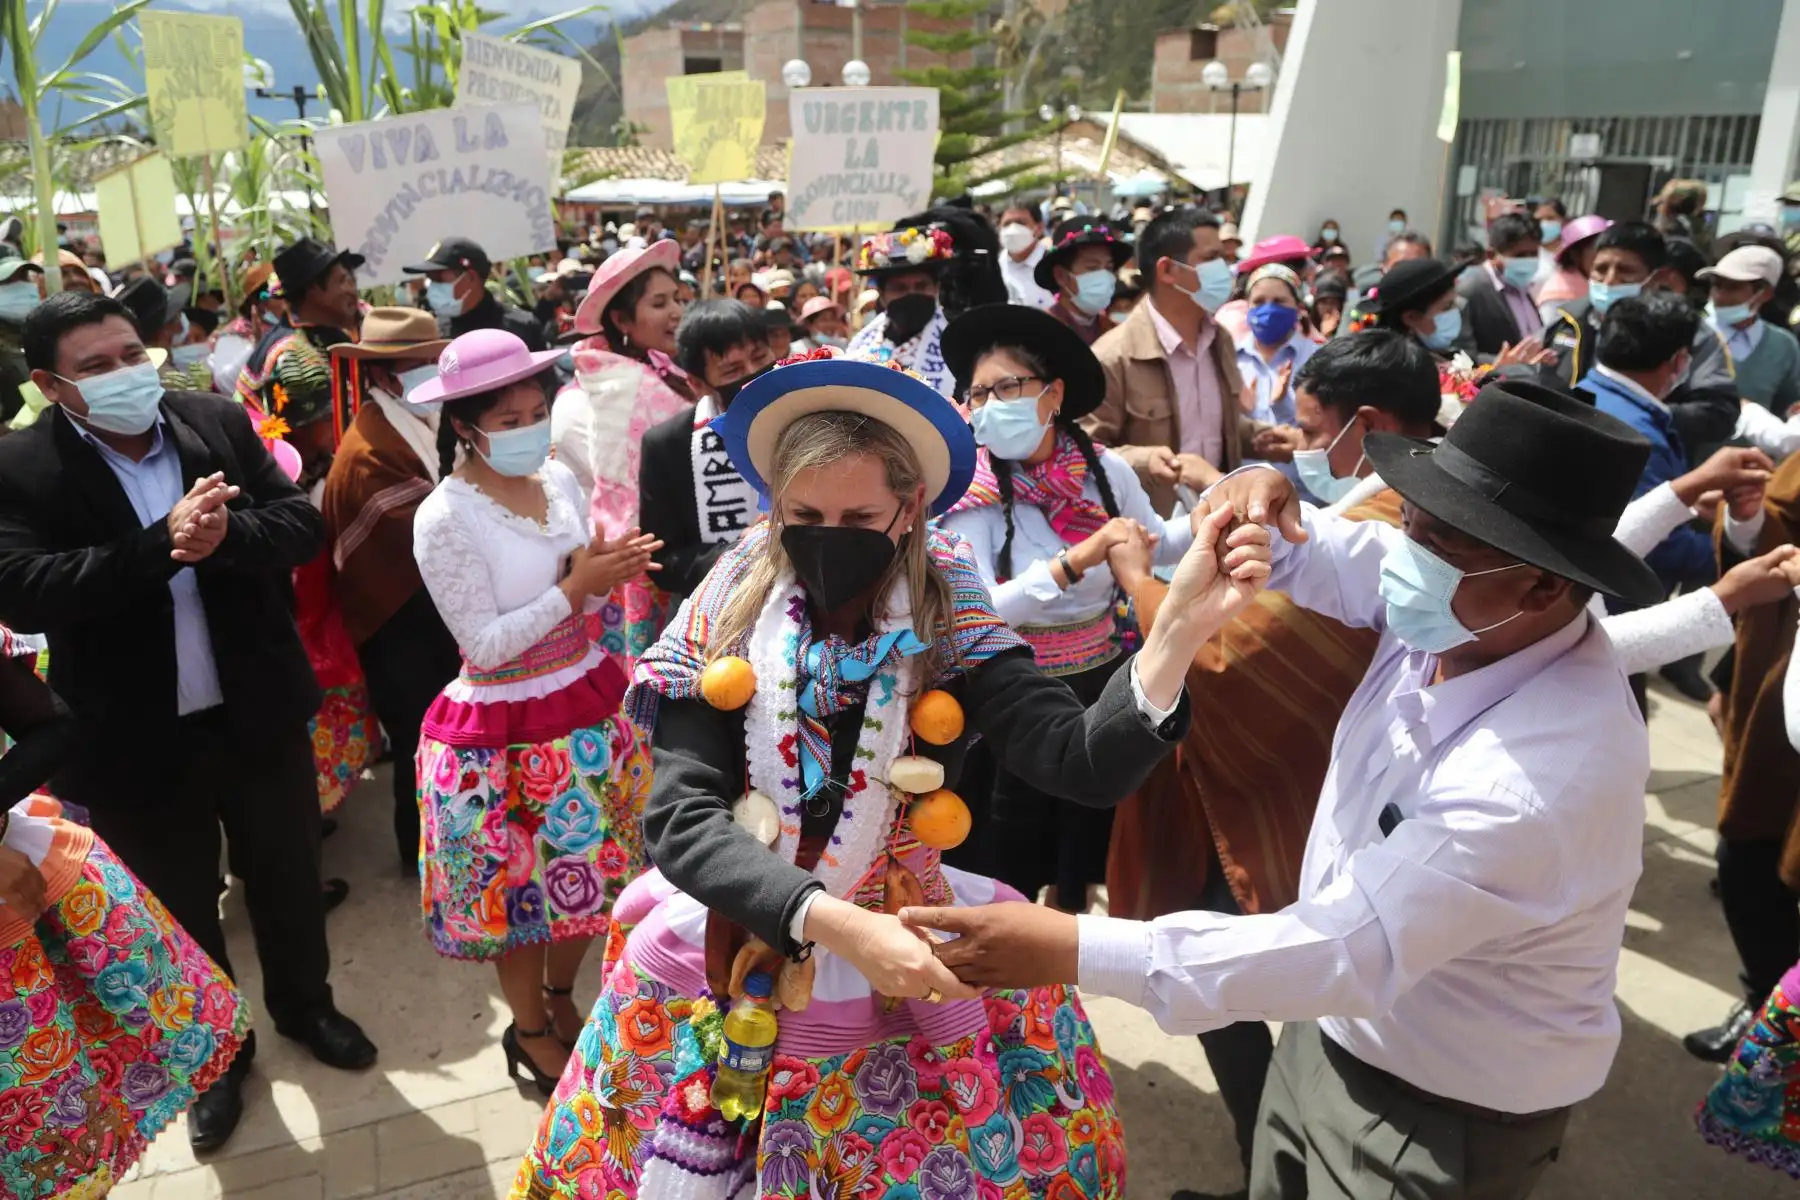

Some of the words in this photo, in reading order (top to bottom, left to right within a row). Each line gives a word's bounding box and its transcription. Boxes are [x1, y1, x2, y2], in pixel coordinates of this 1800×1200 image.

[465, 36, 562, 88] BIENVENIDA
[803, 99, 928, 134] URGENTE
[338, 123, 440, 174] VIVA
[452, 110, 509, 153] LA
[844, 136, 879, 169] LA
[832, 199, 880, 223] CION
